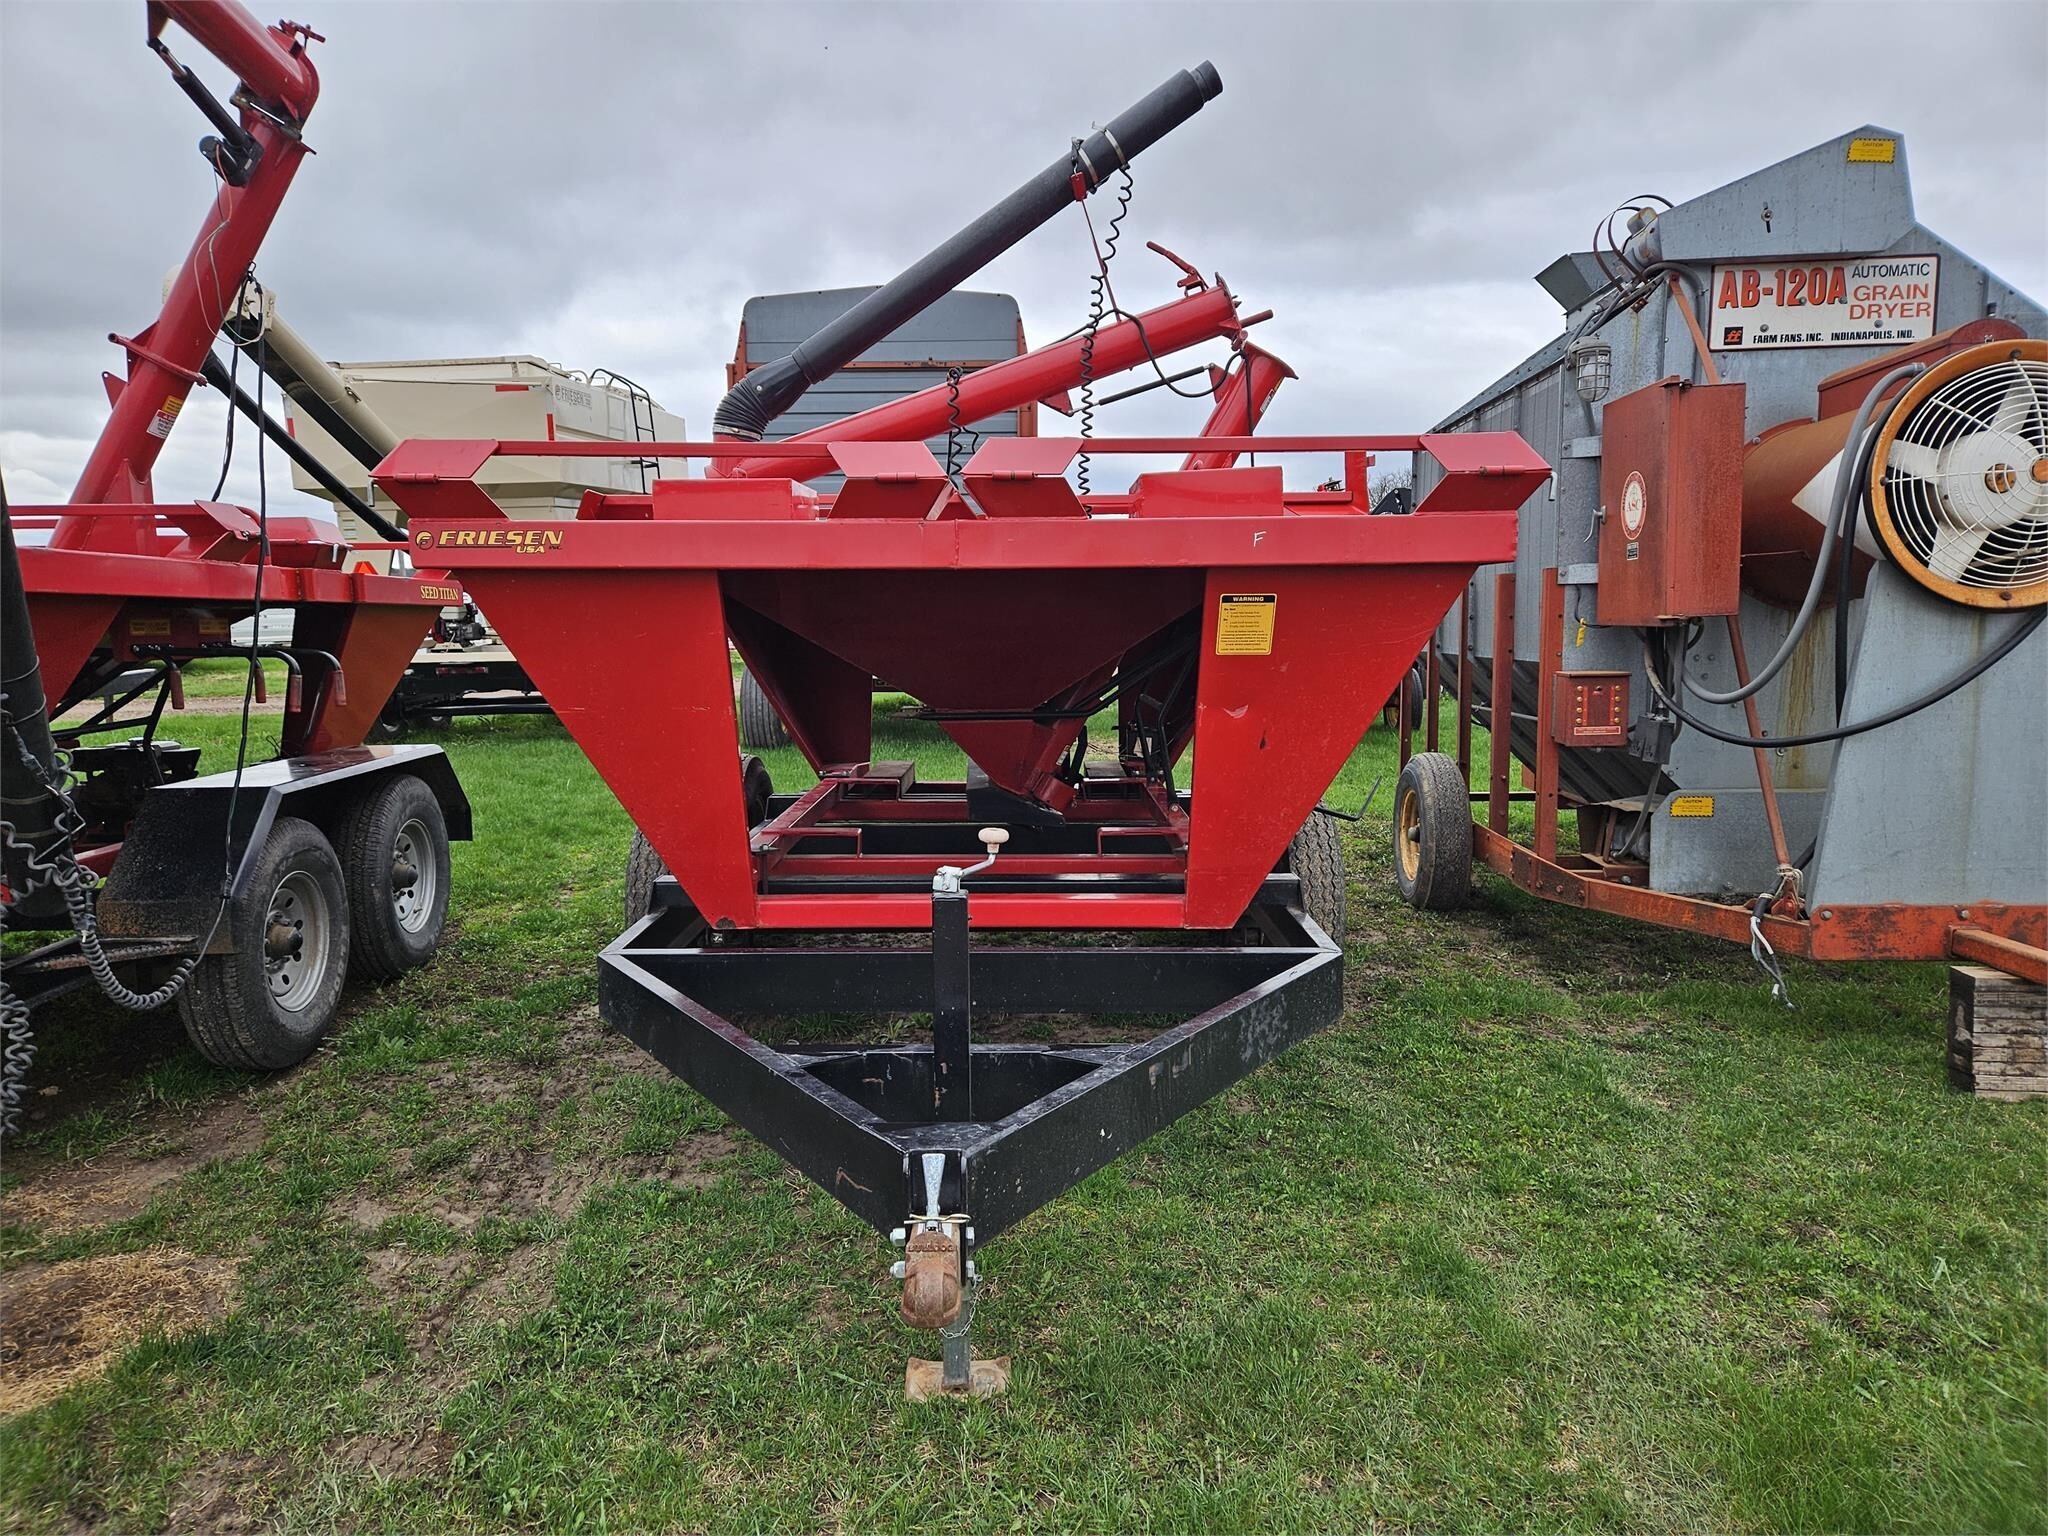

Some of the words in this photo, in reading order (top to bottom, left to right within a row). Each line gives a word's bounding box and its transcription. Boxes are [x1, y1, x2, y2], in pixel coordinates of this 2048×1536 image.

[1852, 263, 1930, 278] AUTOMATIC
[1718, 266, 1847, 309] AB-120A
[1853, 283, 1930, 302] GRAIN
[1849, 303, 1931, 320] DRYER
[1753, 333, 1778, 344] FARM
[438, 530, 564, 546] FRIESEN
[1254, 531, 1267, 547] F
[516, 545, 546, 554] USA
[420, 585, 439, 599] SEED
[439, 587, 459, 600] TITAN
